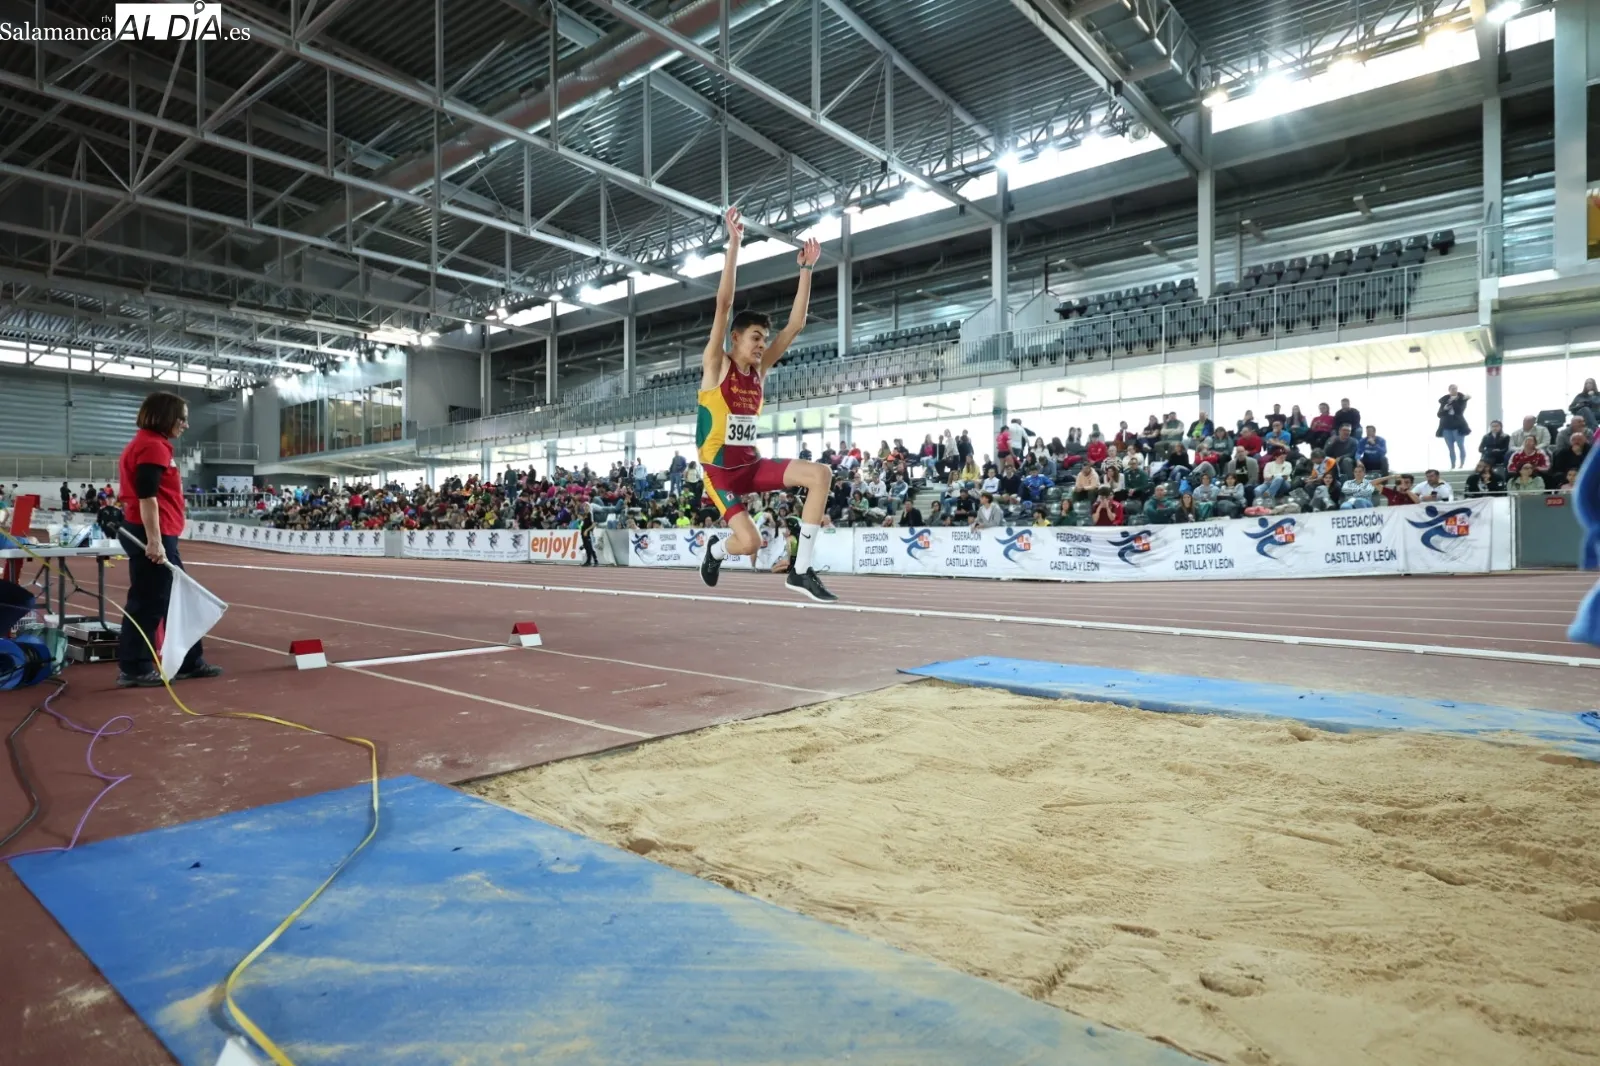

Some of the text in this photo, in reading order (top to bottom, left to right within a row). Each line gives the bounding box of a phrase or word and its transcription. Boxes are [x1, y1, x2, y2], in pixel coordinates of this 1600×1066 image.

[728, 423, 757, 441] 3942
[1331, 511, 1384, 529] FEDERACIÓN
[1181, 524, 1224, 539] FEDERACIÓN
[531, 531, 579, 560] enjoy!
[1335, 532, 1382, 546] ATLETISMO
[1184, 543, 1222, 555] ATLETISMO
[1324, 546, 1398, 563] CASTILLA Y LEÓN
[946, 557, 969, 567] CASTILLA
[1050, 560, 1077, 571] CASTILLA
[1174, 556, 1235, 570] CASTILLA Y LEÓN
